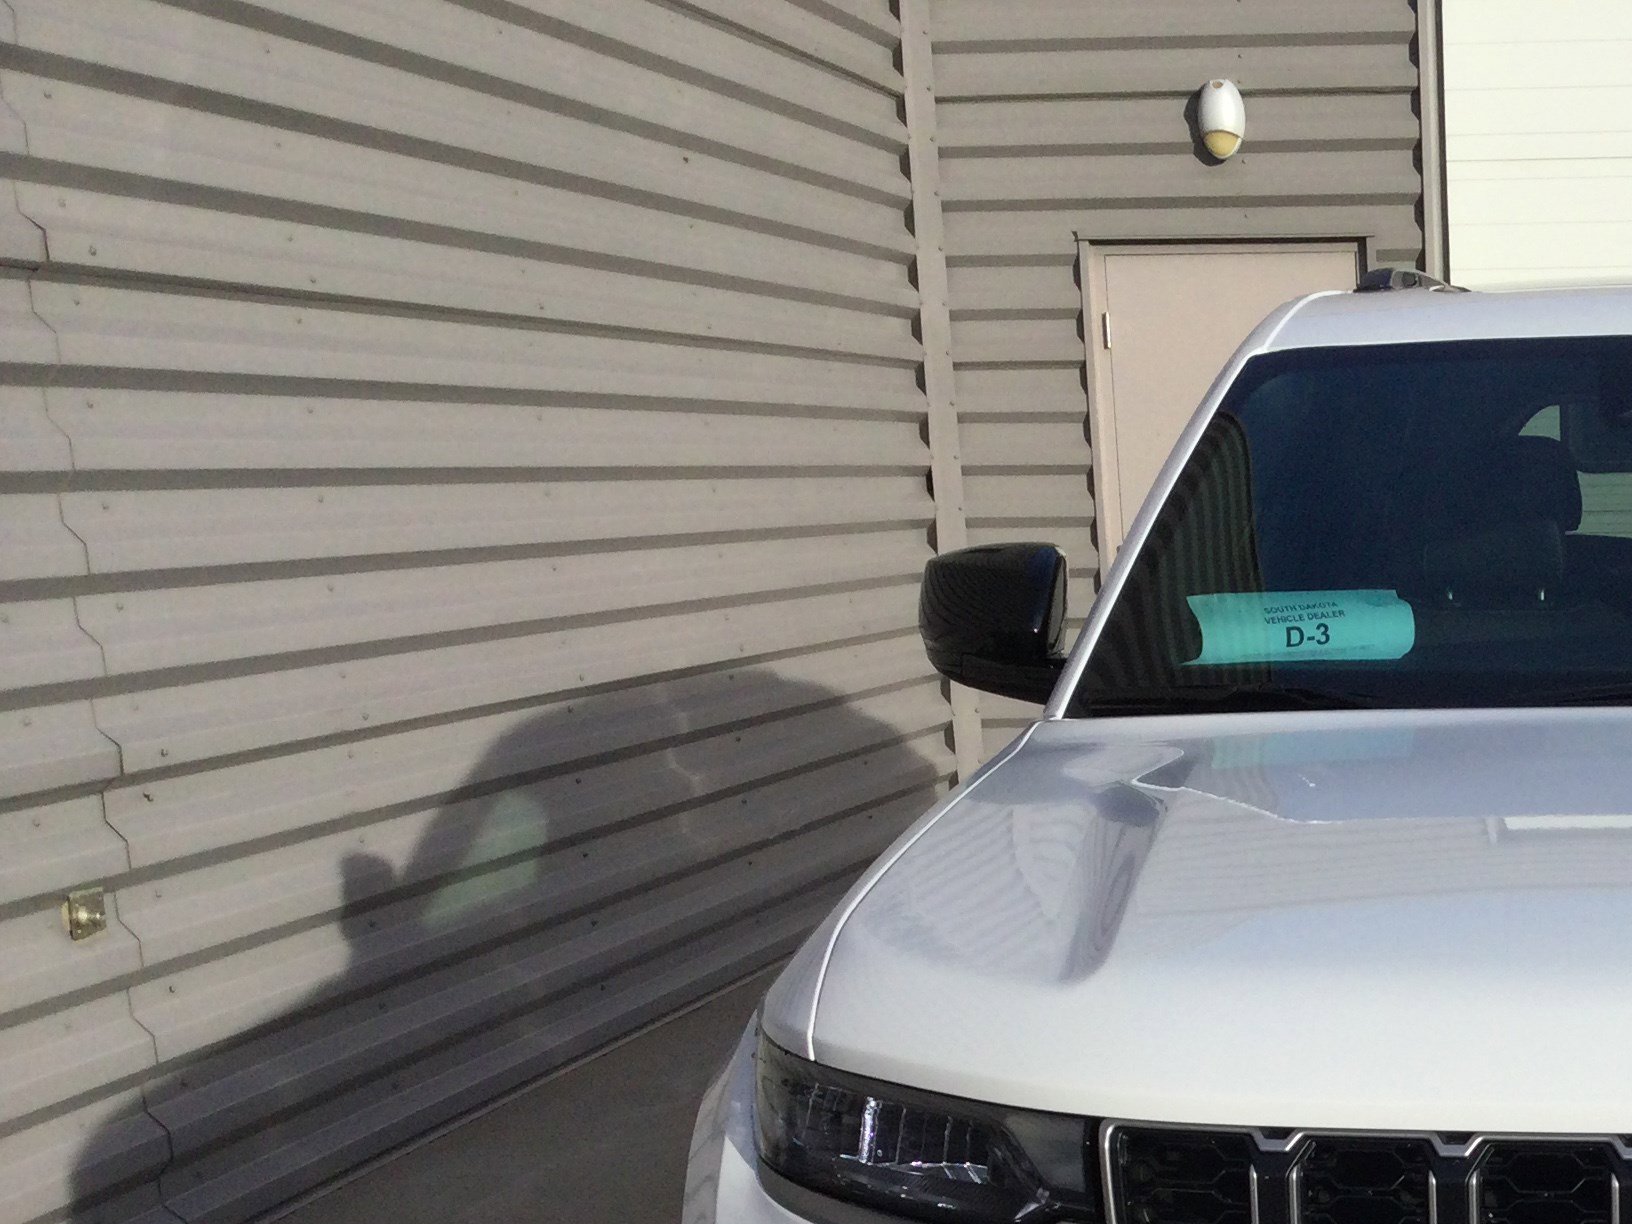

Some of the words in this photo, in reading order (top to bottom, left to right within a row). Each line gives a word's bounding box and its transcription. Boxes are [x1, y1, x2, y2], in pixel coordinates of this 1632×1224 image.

[1264, 604, 1297, 614] SOUTH
[1299, 601, 1338, 611] DAKOTA
[1264, 613, 1305, 625] VEHICLE
[1307, 609, 1345, 620] DEALER
[1285, 622, 1330, 648] D-3
